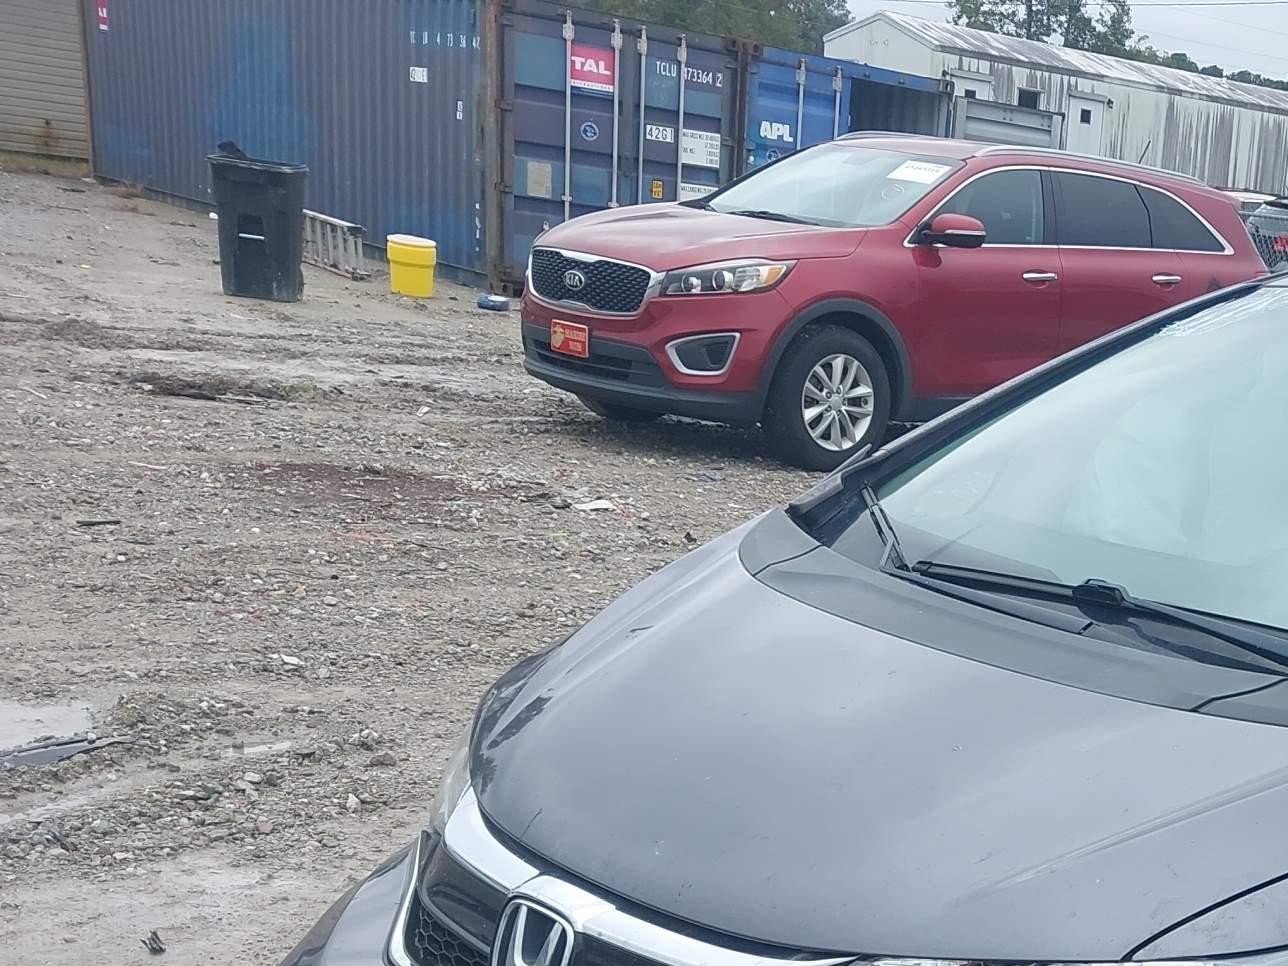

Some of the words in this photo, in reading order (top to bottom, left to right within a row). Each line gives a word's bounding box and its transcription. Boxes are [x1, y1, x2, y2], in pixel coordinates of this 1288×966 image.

[571, 55, 611, 76] TAL
[656, 61, 677, 78] TCLU
[647, 126, 673, 142] 42G1
[760, 120, 794, 143] APL
[564, 273, 581, 288] KIA
